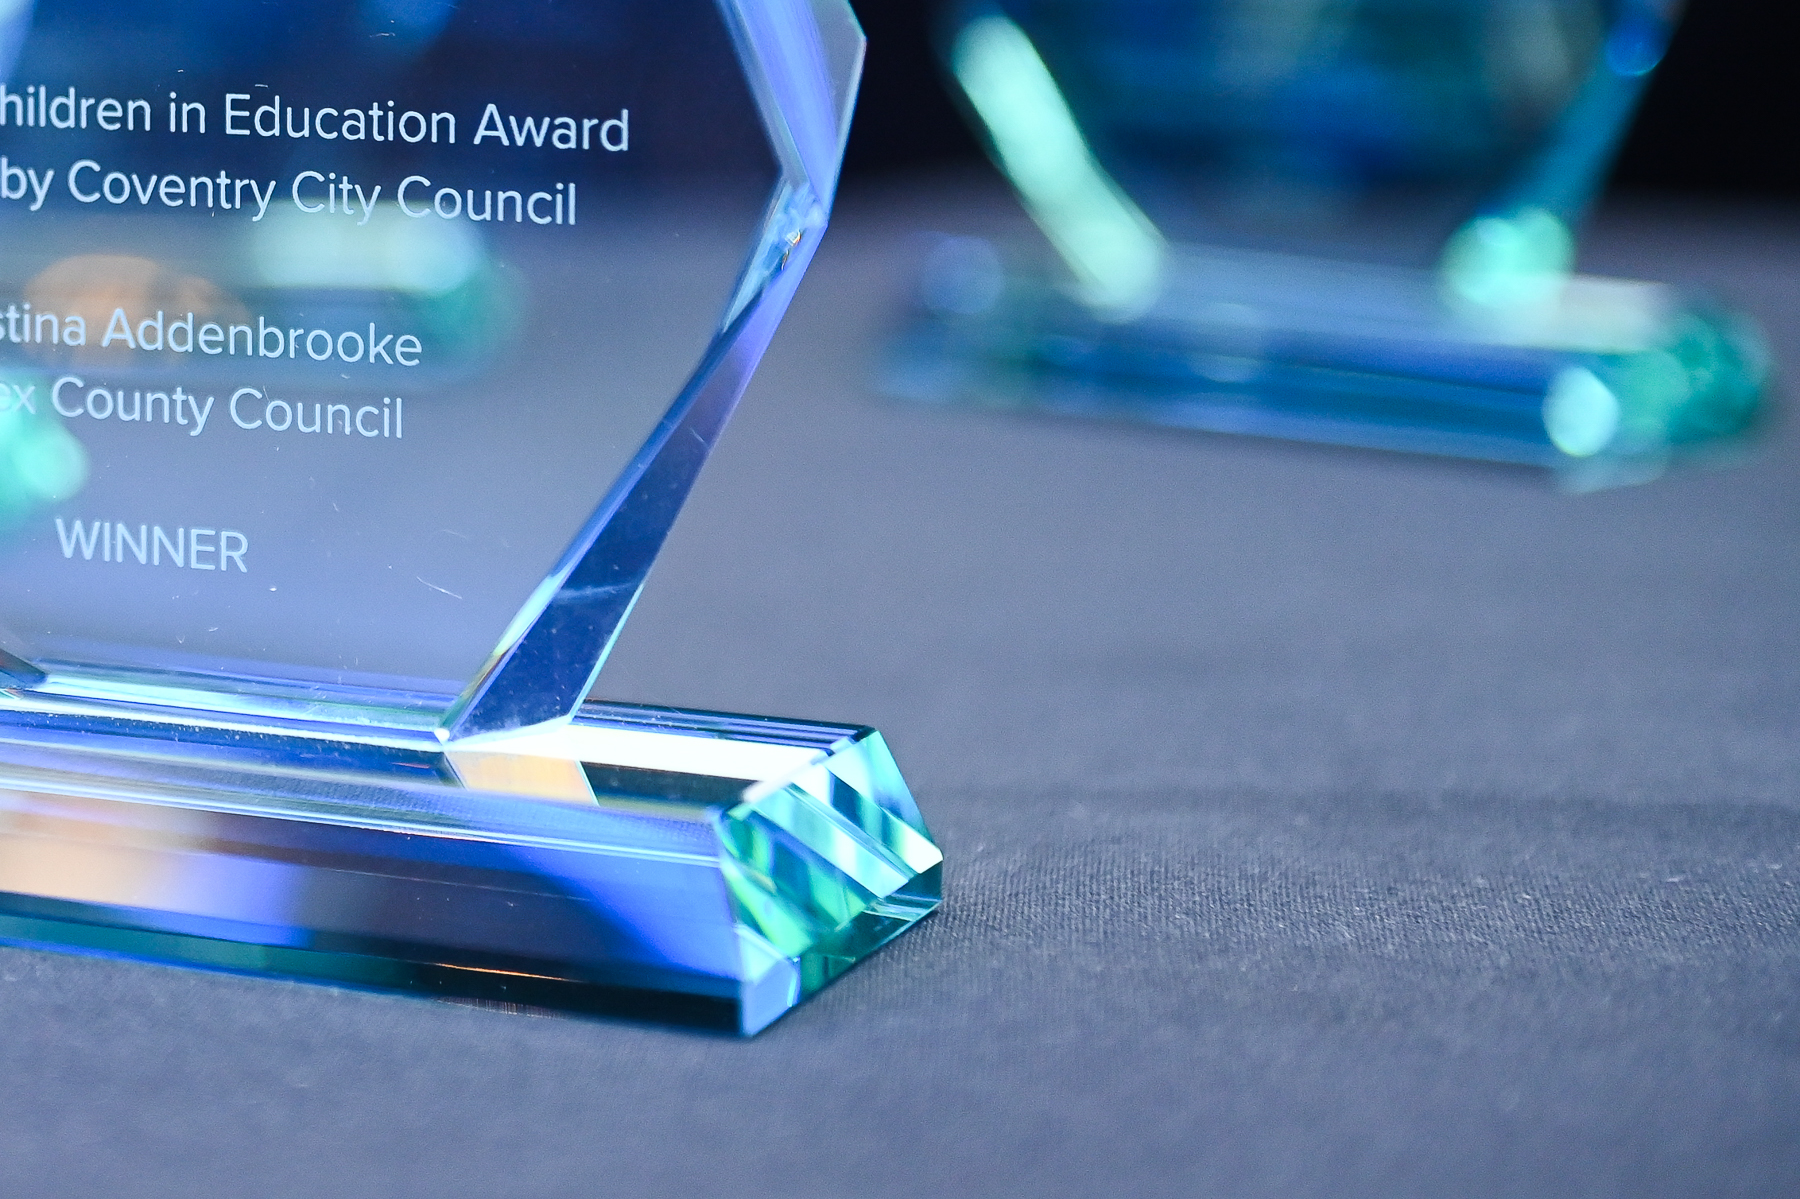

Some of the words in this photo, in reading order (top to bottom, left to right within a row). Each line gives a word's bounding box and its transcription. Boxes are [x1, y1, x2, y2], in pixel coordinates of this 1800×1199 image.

[169, 92, 206, 134] in
[225, 93, 456, 144] Education
[473, 103, 629, 152] Award
[0, 155, 55, 211] by
[68, 159, 276, 222] Coventry
[292, 171, 382, 226] City
[397, 175, 577, 225] Council
[101, 308, 423, 367] Addenbrooke
[51, 376, 215, 437] County
[229, 387, 404, 439] Council
[55, 517, 249, 573] WINNER
